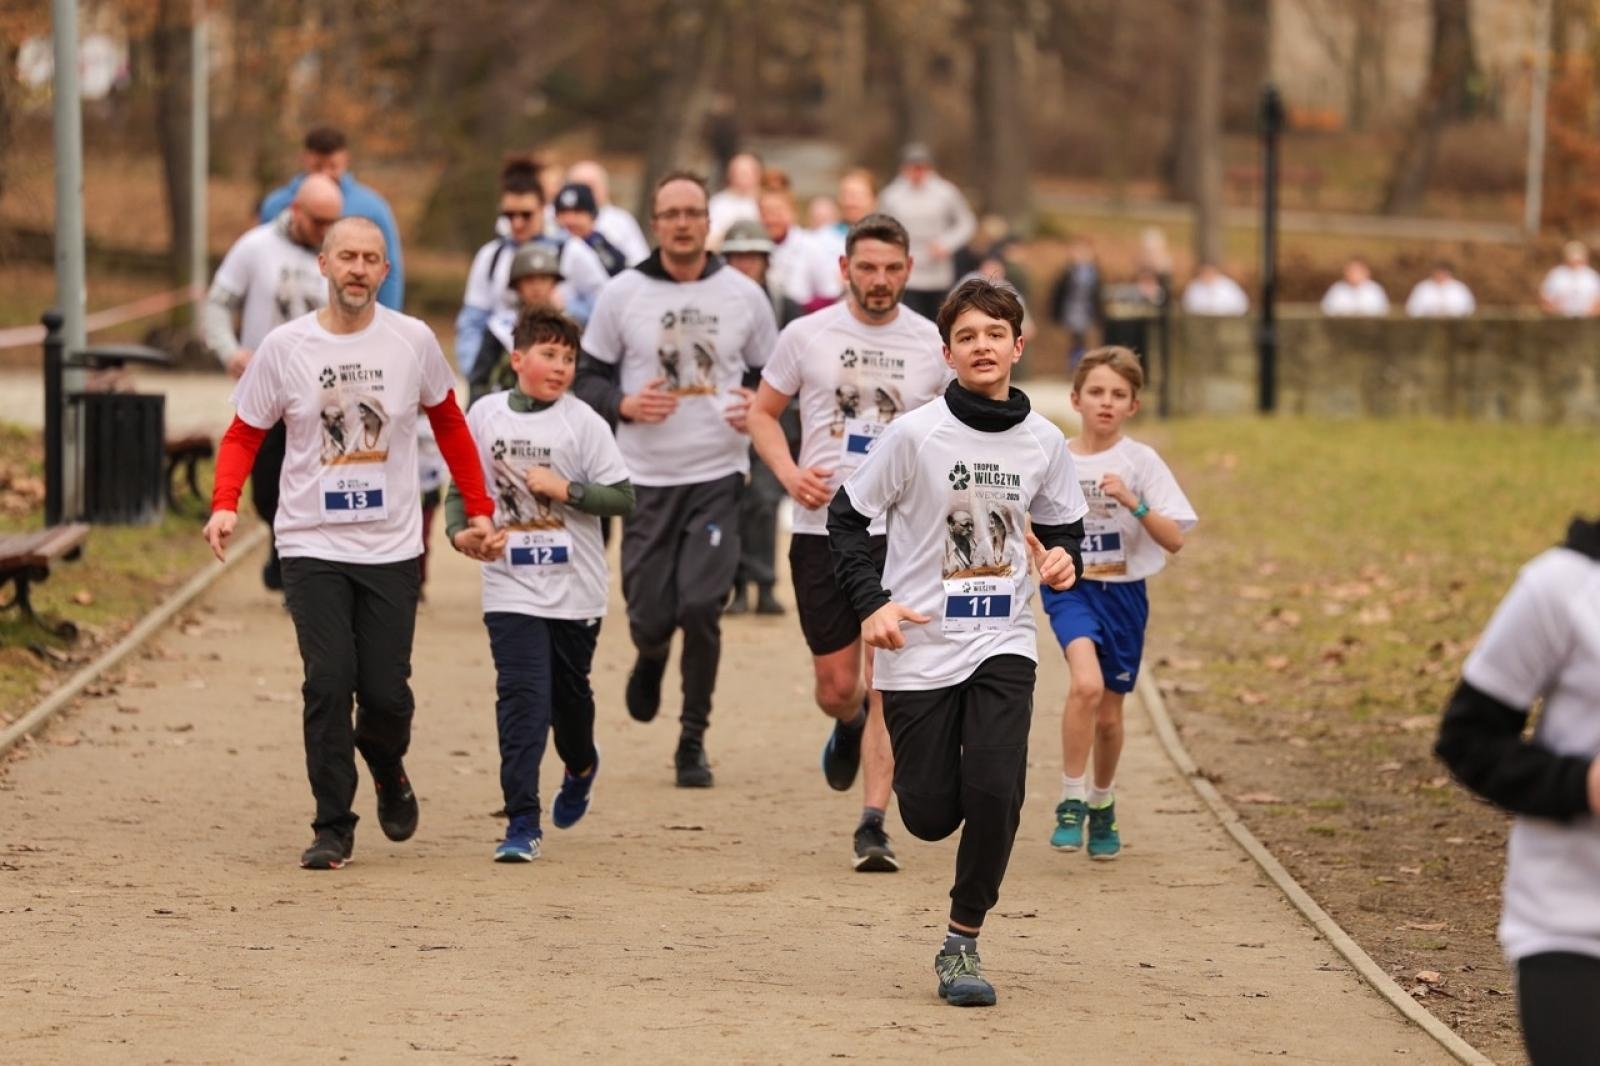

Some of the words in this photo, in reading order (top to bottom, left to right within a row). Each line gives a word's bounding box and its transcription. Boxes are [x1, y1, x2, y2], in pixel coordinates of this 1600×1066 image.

[862, 356, 904, 368] WILCZYM
[340, 369, 382, 381] WILCZYM
[510, 447, 551, 457] WILCZYM
[973, 463, 1000, 472] TROPEM
[974, 472, 1020, 486] WILCZYM
[344, 491, 369, 510] 13
[1080, 535, 1102, 551] 41
[529, 547, 554, 565] 12
[969, 596, 991, 616] 11
